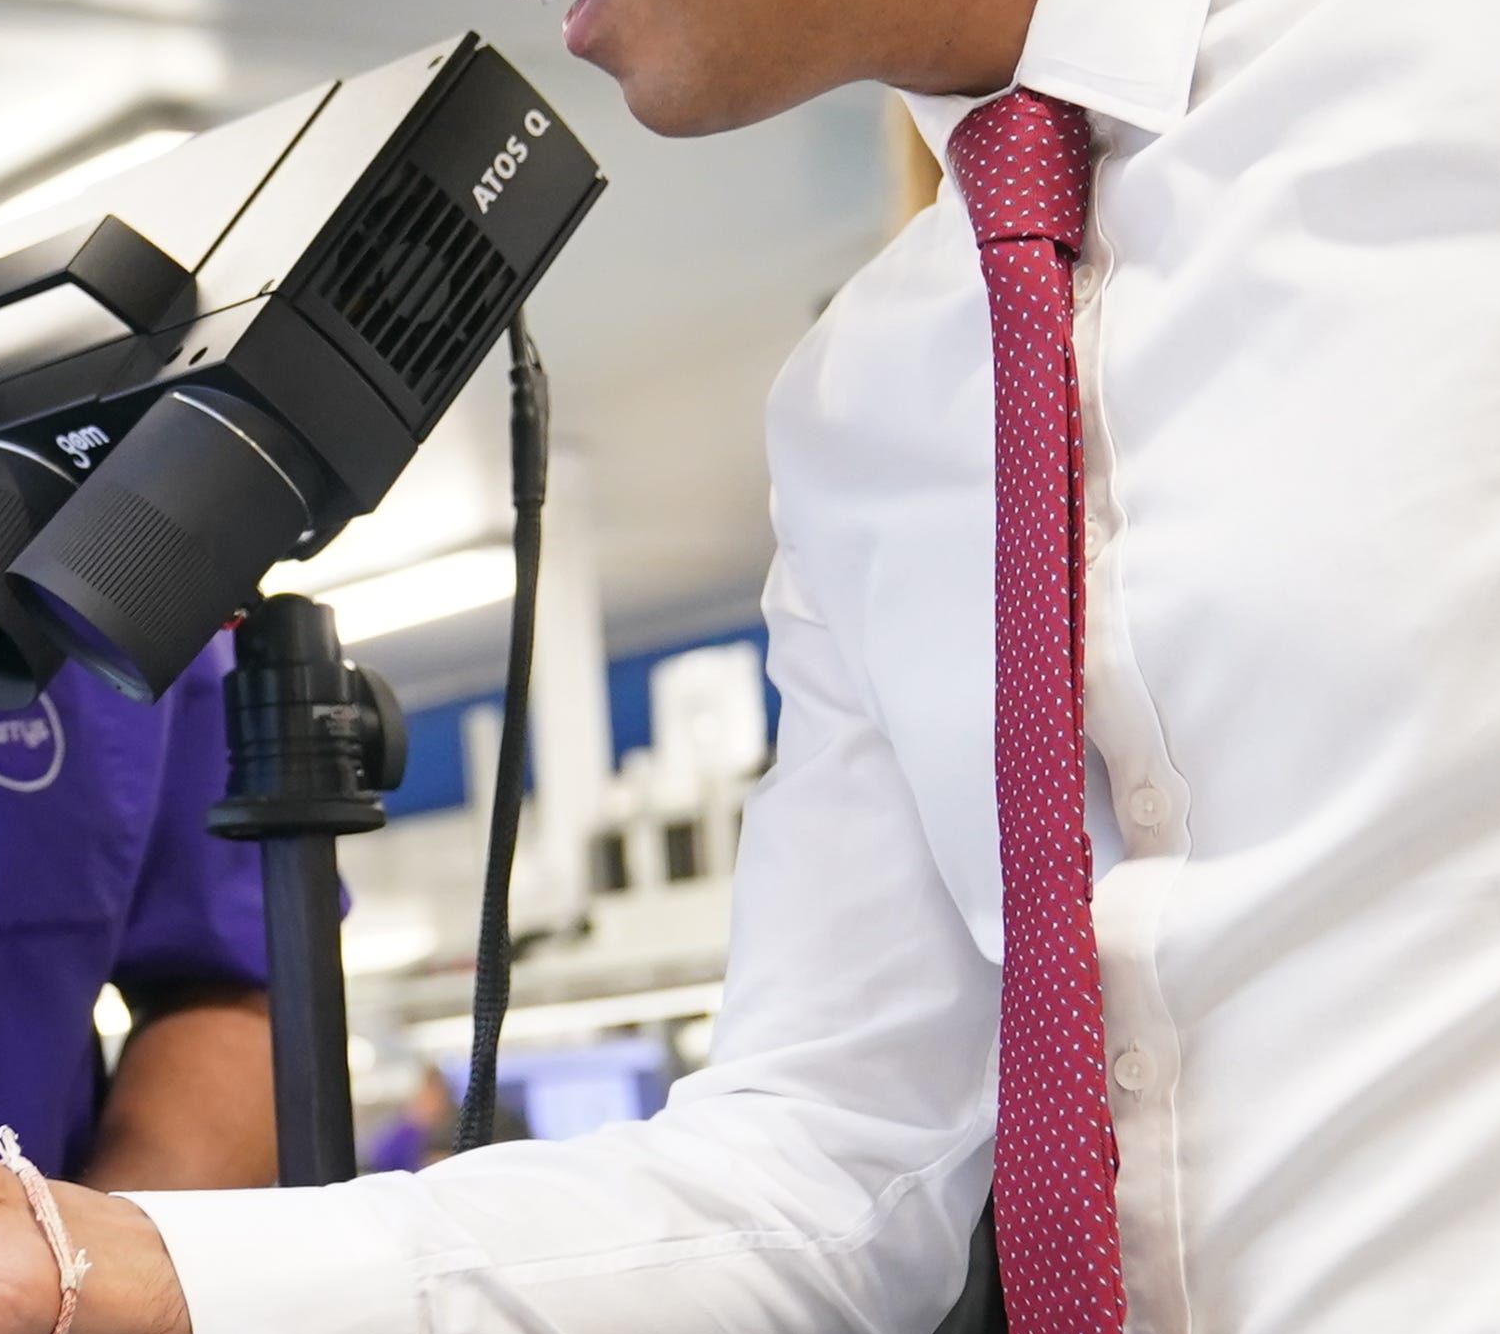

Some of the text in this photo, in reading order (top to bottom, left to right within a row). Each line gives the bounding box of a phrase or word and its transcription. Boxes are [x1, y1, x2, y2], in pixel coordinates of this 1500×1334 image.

[472, 108, 551, 215] ATOS Q
[55, 424, 111, 469] gom
